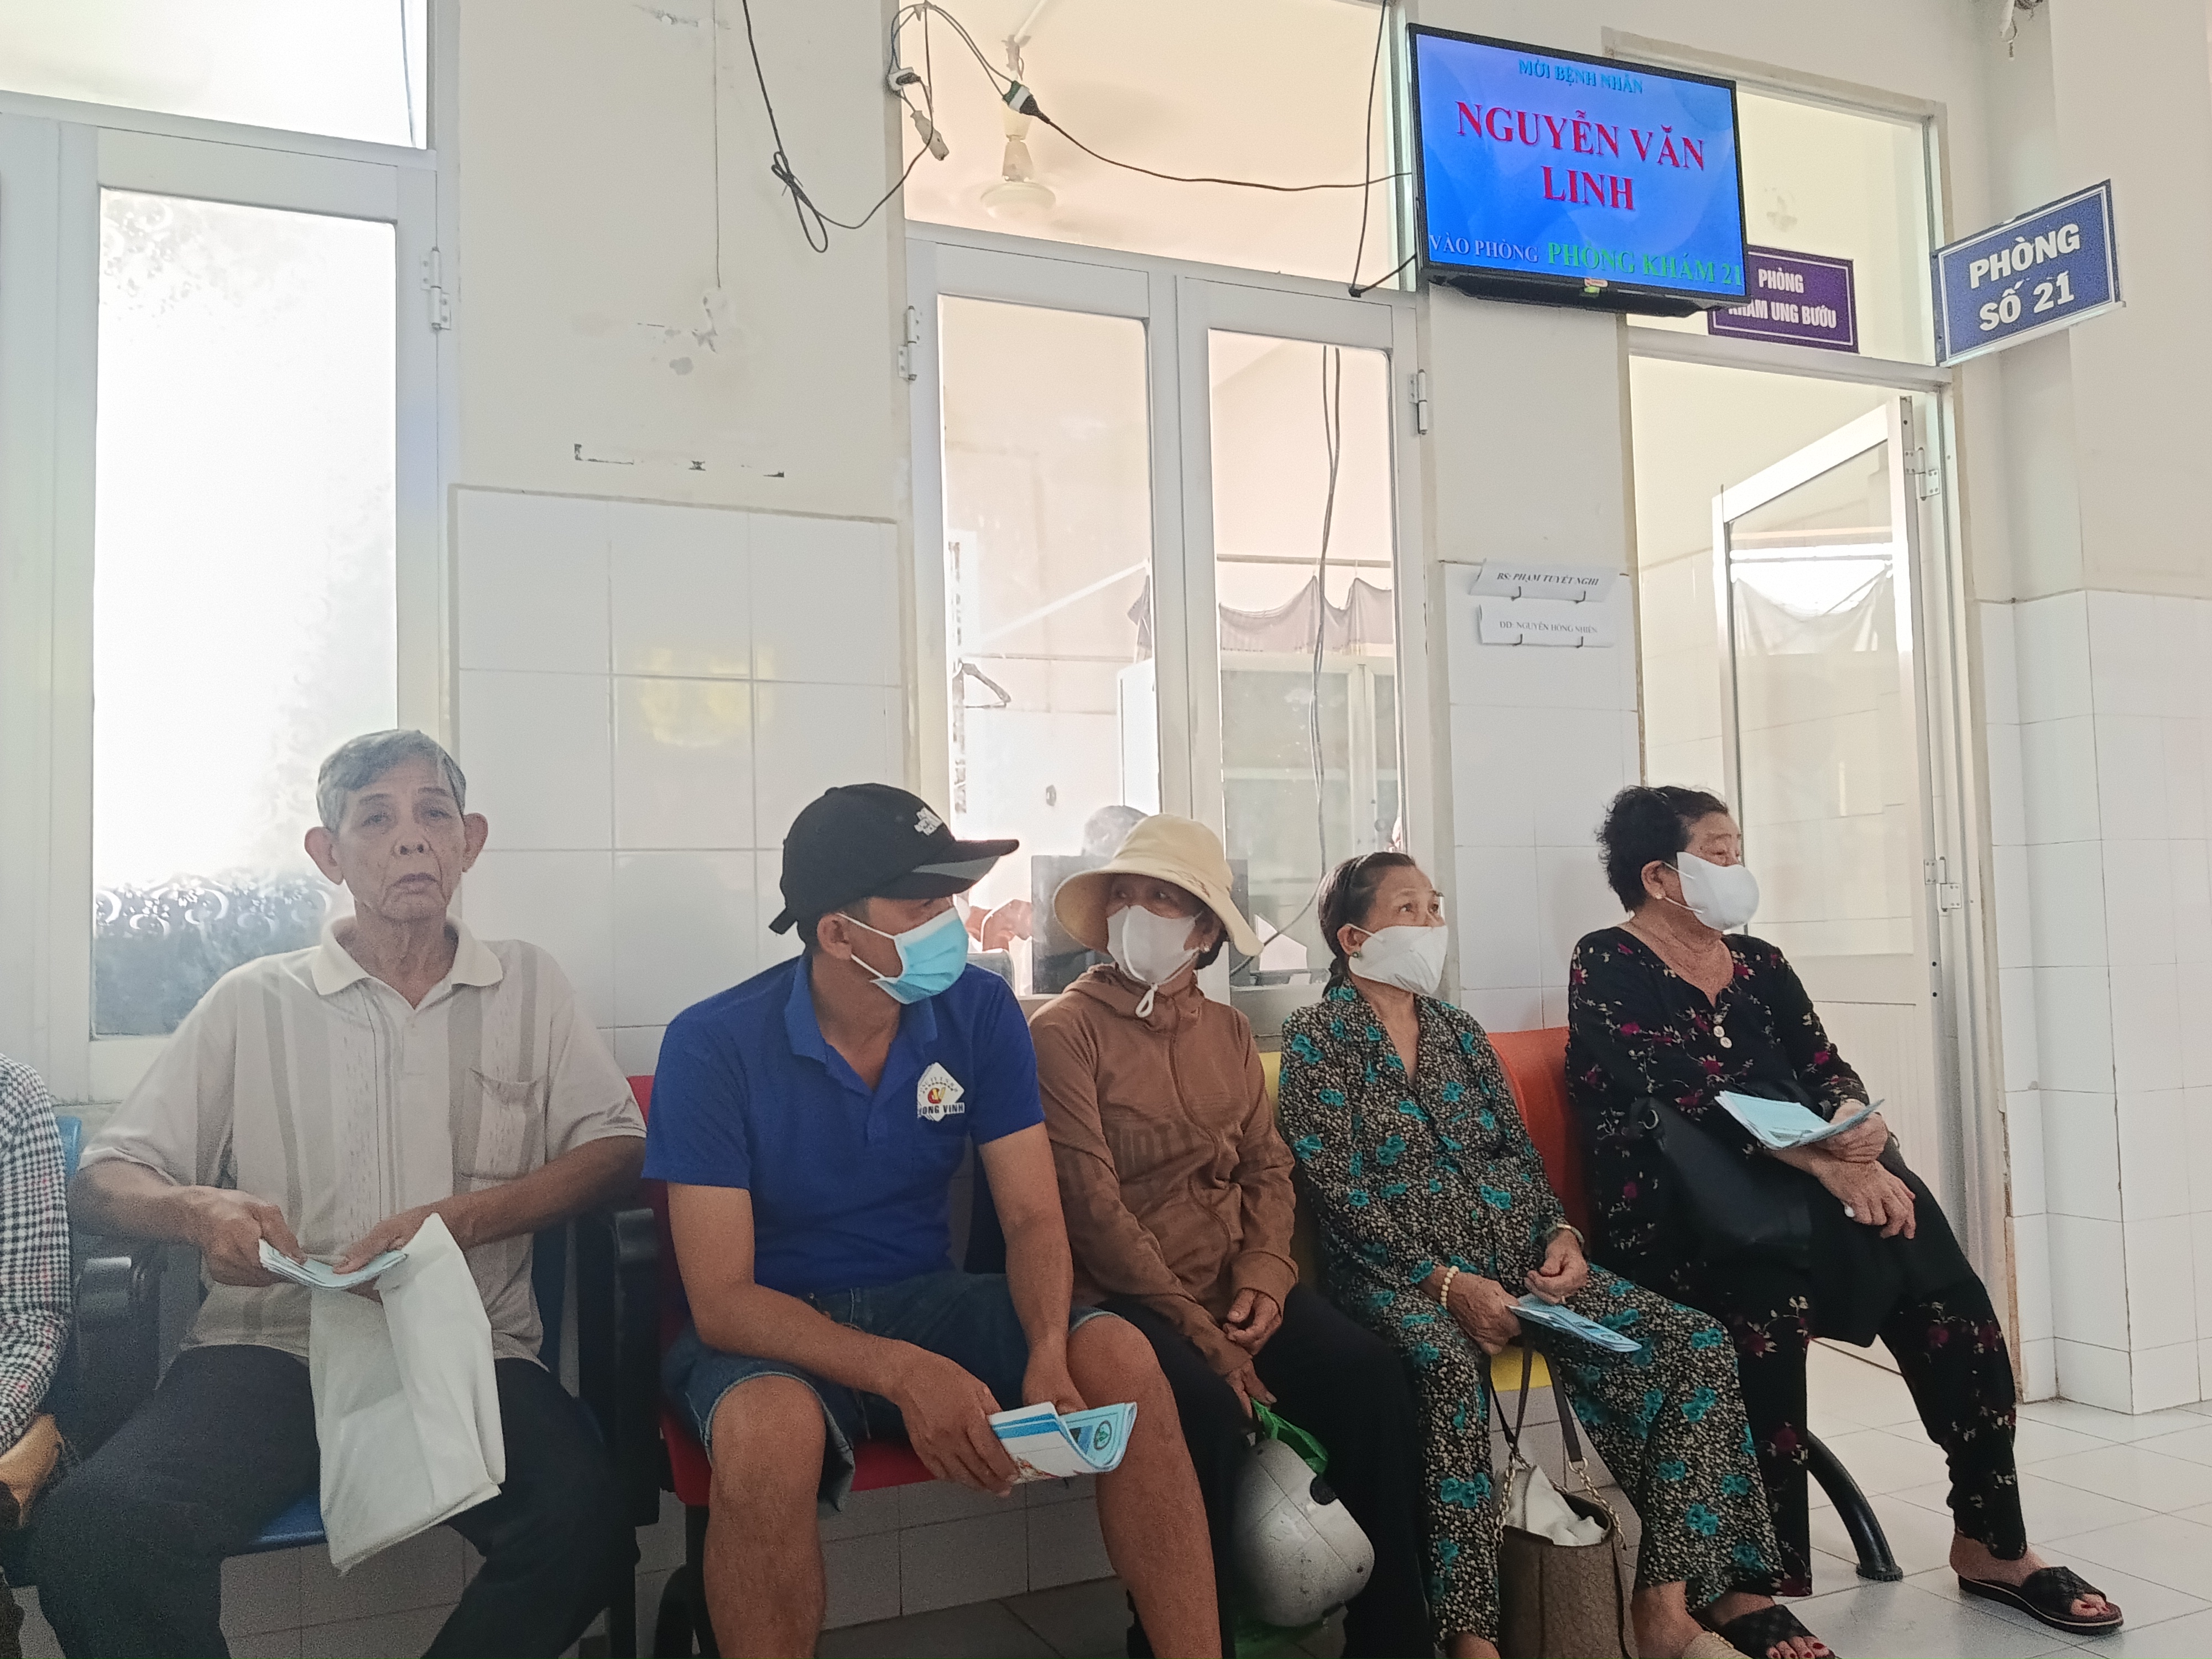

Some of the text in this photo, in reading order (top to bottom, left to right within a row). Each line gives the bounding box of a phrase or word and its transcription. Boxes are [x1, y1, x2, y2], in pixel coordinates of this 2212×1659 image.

[1555, 65, 1597, 86] BỆNH
[1600, 72, 1642, 93] NHÂN
[1455, 101, 1704, 170] NGUYỄN VĂN
[1541, 166, 1634, 210] LINH
[1430, 232, 1742, 286] VÀO PHÒNG PHÒNG KHÁM 21
[1970, 223, 2080, 289] PHÒNG
[1758, 267, 1804, 294] PHÒNG
[1979, 270, 2074, 331] SỐ 21
[1771, 301, 1799, 323] UNG
[1802, 305, 1837, 328] BƯỚU
[919, 1104, 963, 1116] ONG VINH
